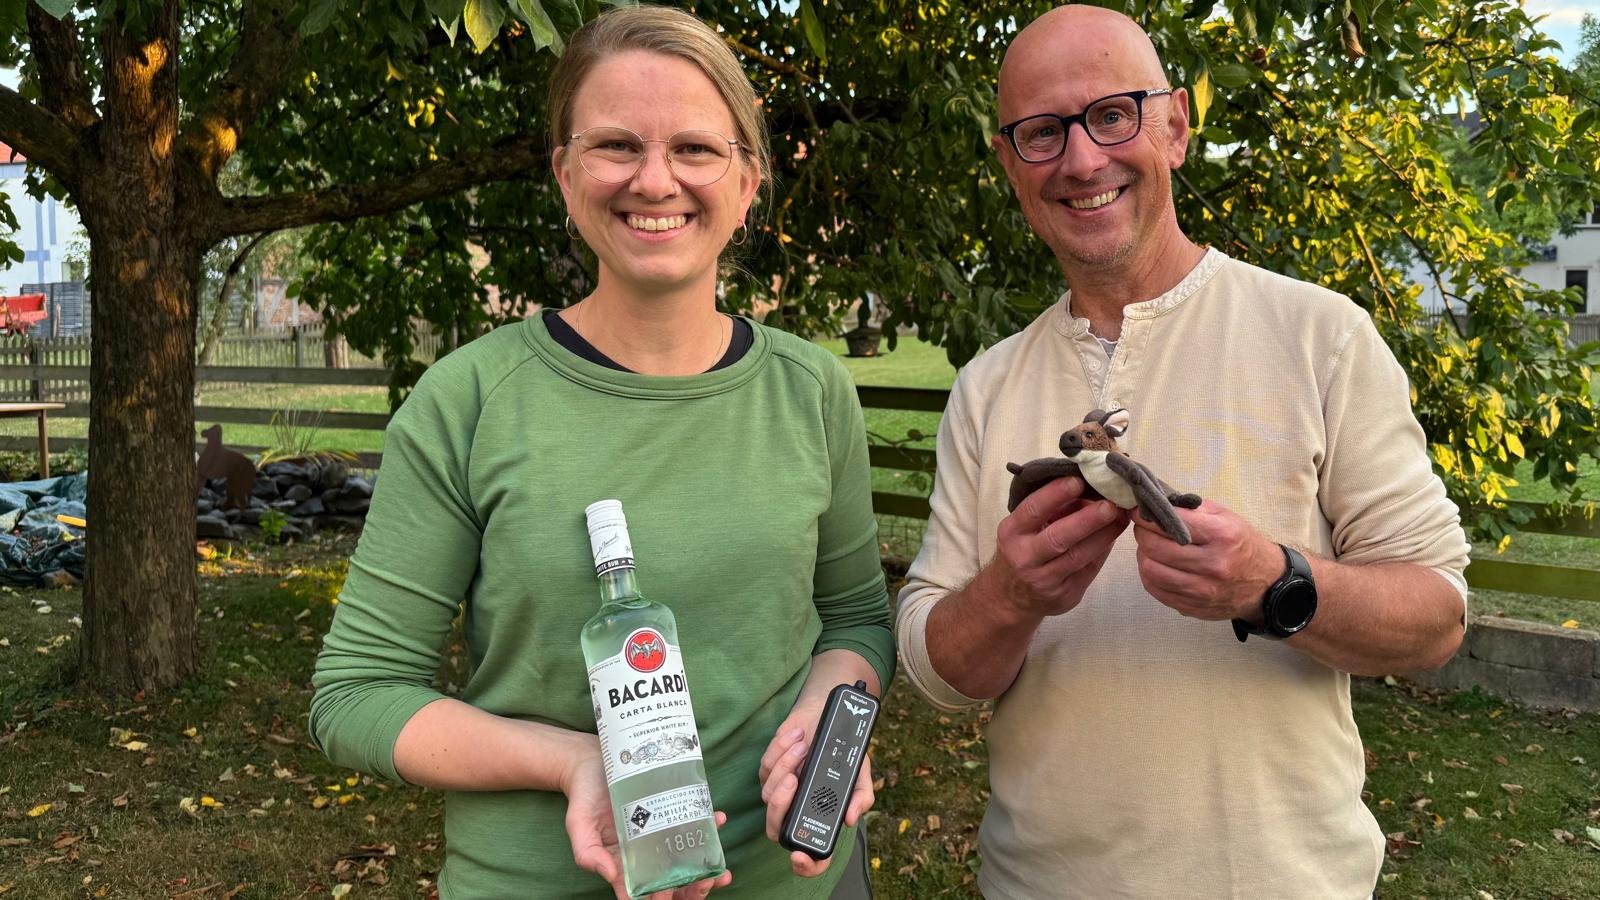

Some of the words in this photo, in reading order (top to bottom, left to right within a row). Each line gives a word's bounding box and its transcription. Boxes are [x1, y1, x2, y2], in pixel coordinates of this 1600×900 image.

[620, 705, 653, 720] CARTA
[656, 699, 687, 710] BLANCA
[632, 726, 660, 738] SUPERIOR
[661, 723, 676, 731] WHITE
[646, 791, 687, 807] ESTABLECIDO
[653, 805, 688, 821] FAMILIA
[802, 815, 831, 831] FLEDERMAUS
[803, 822, 827, 835] DETEKTOR
[664, 829, 705, 855] 1862
[796, 828, 810, 839] ELV
[811, 836, 827, 847] FMD1
